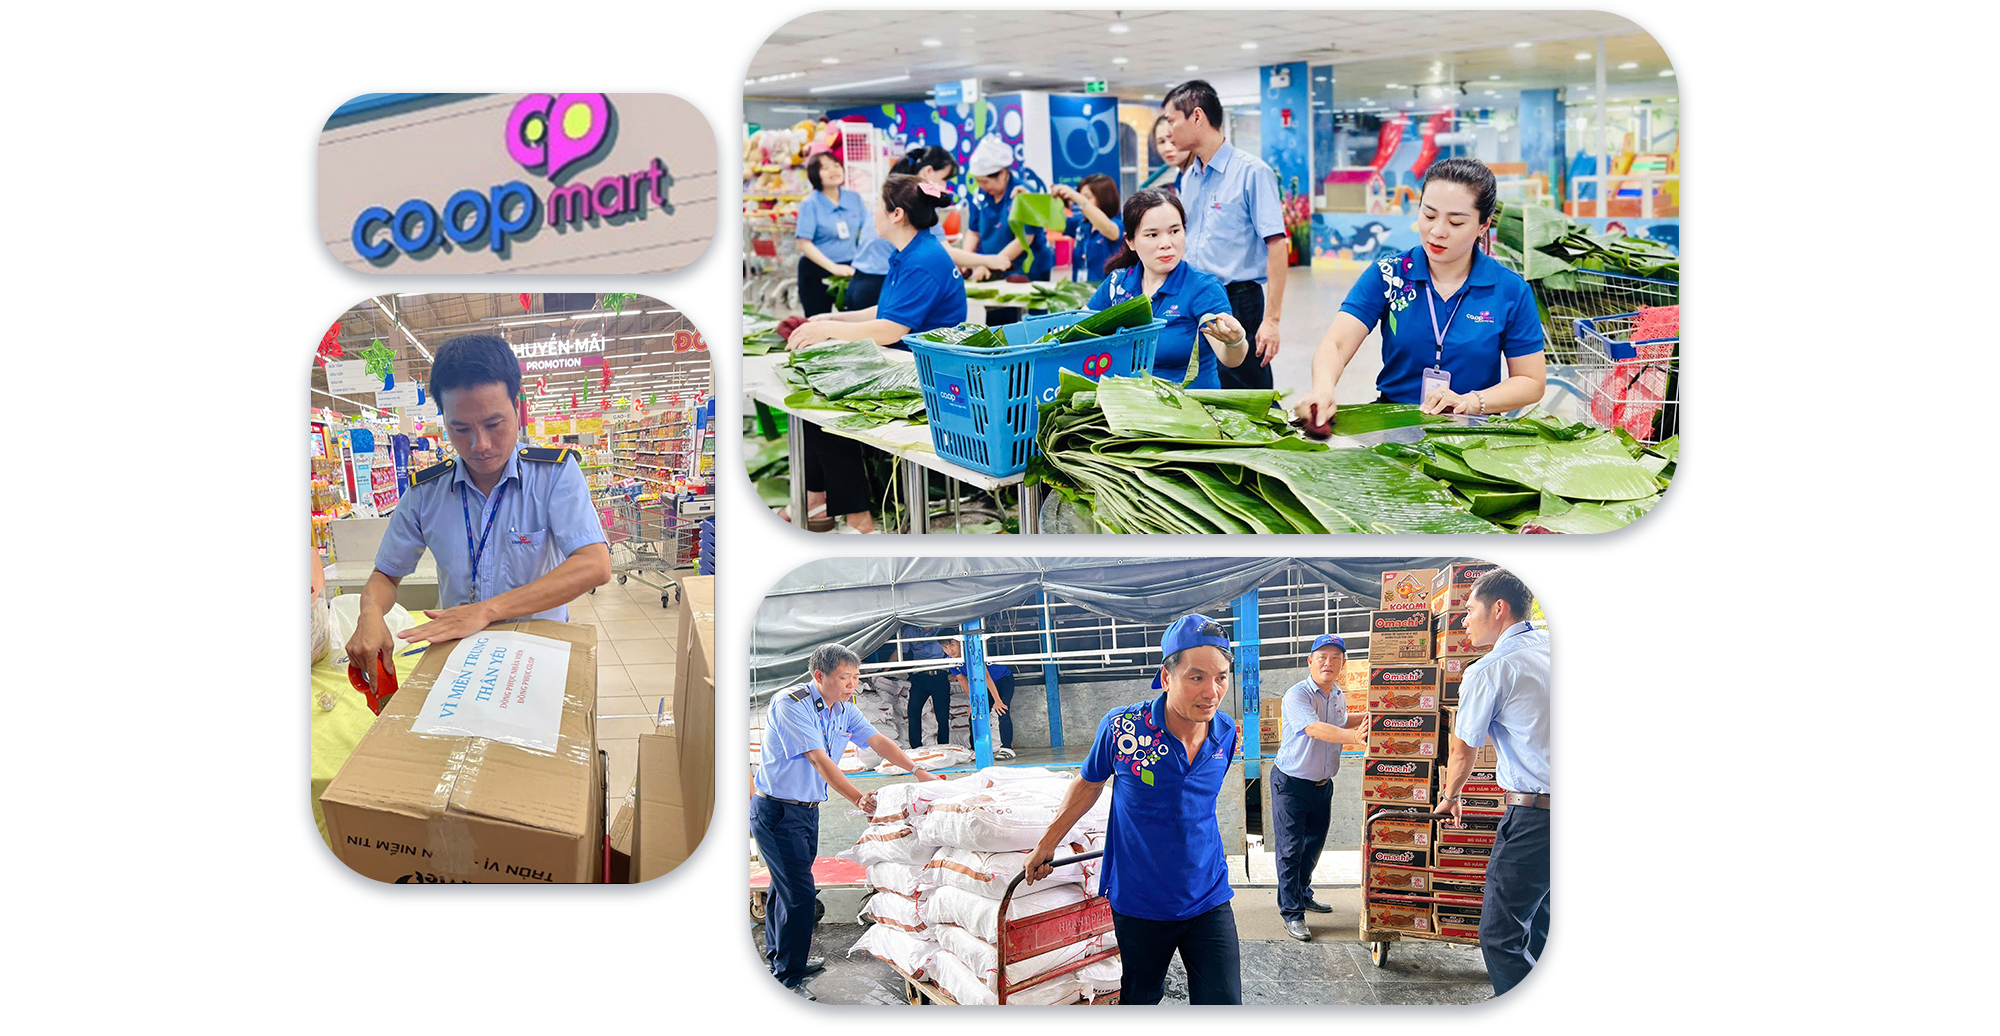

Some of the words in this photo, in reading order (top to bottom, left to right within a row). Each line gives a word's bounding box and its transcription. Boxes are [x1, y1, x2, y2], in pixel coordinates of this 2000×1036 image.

[547, 157, 669, 227] mart
[526, 358, 581, 370] PROMOTION
[1376, 617, 1418, 628] Omachi
[463, 638, 489, 667] TRUNG
[1383, 672, 1418, 680] Omachi
[447, 670, 473, 700] MIỀN
[475, 667, 500, 701] THÂN
[439, 702, 458, 718] VÌ
[1383, 719, 1418, 728] Omachi
[1377, 764, 1411, 773] Omachi
[347, 835, 371, 848] TIN
[1375, 852, 1409, 862] Omachi
[484, 858, 500, 872] VỊ
[506, 864, 554, 882] TRÒN
